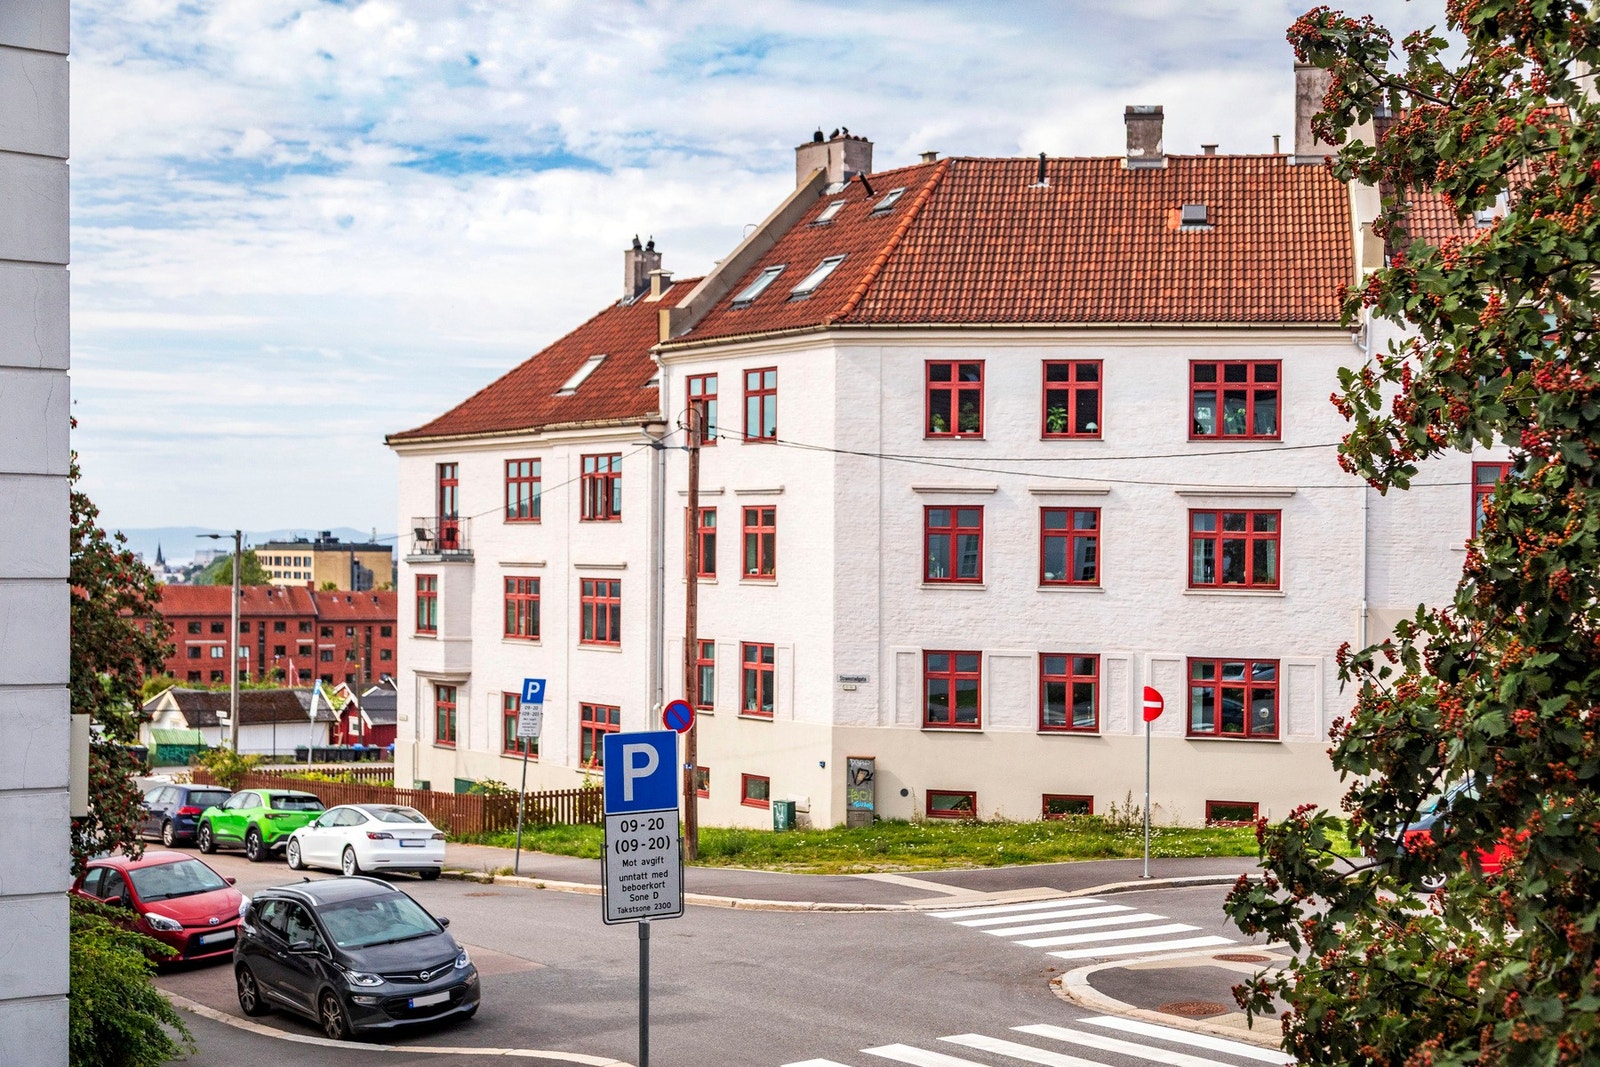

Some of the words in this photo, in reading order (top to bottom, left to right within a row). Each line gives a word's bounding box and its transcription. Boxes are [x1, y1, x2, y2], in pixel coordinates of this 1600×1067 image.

[527, 681, 540, 700] P
[622, 743, 660, 802] P
[620, 818, 664, 833] 09-20
[615, 836, 670, 854] (09-20)
[622, 858, 637, 868] Mot
[642, 856, 664, 866] avgift
[618, 872, 648, 882] unntatt
[652, 870, 668, 878] med
[622, 881, 666, 892] beboerkort
[630, 893, 649, 902] Sone
[618, 905, 650, 914] Takstsone
[654, 902, 672, 910] 2300
